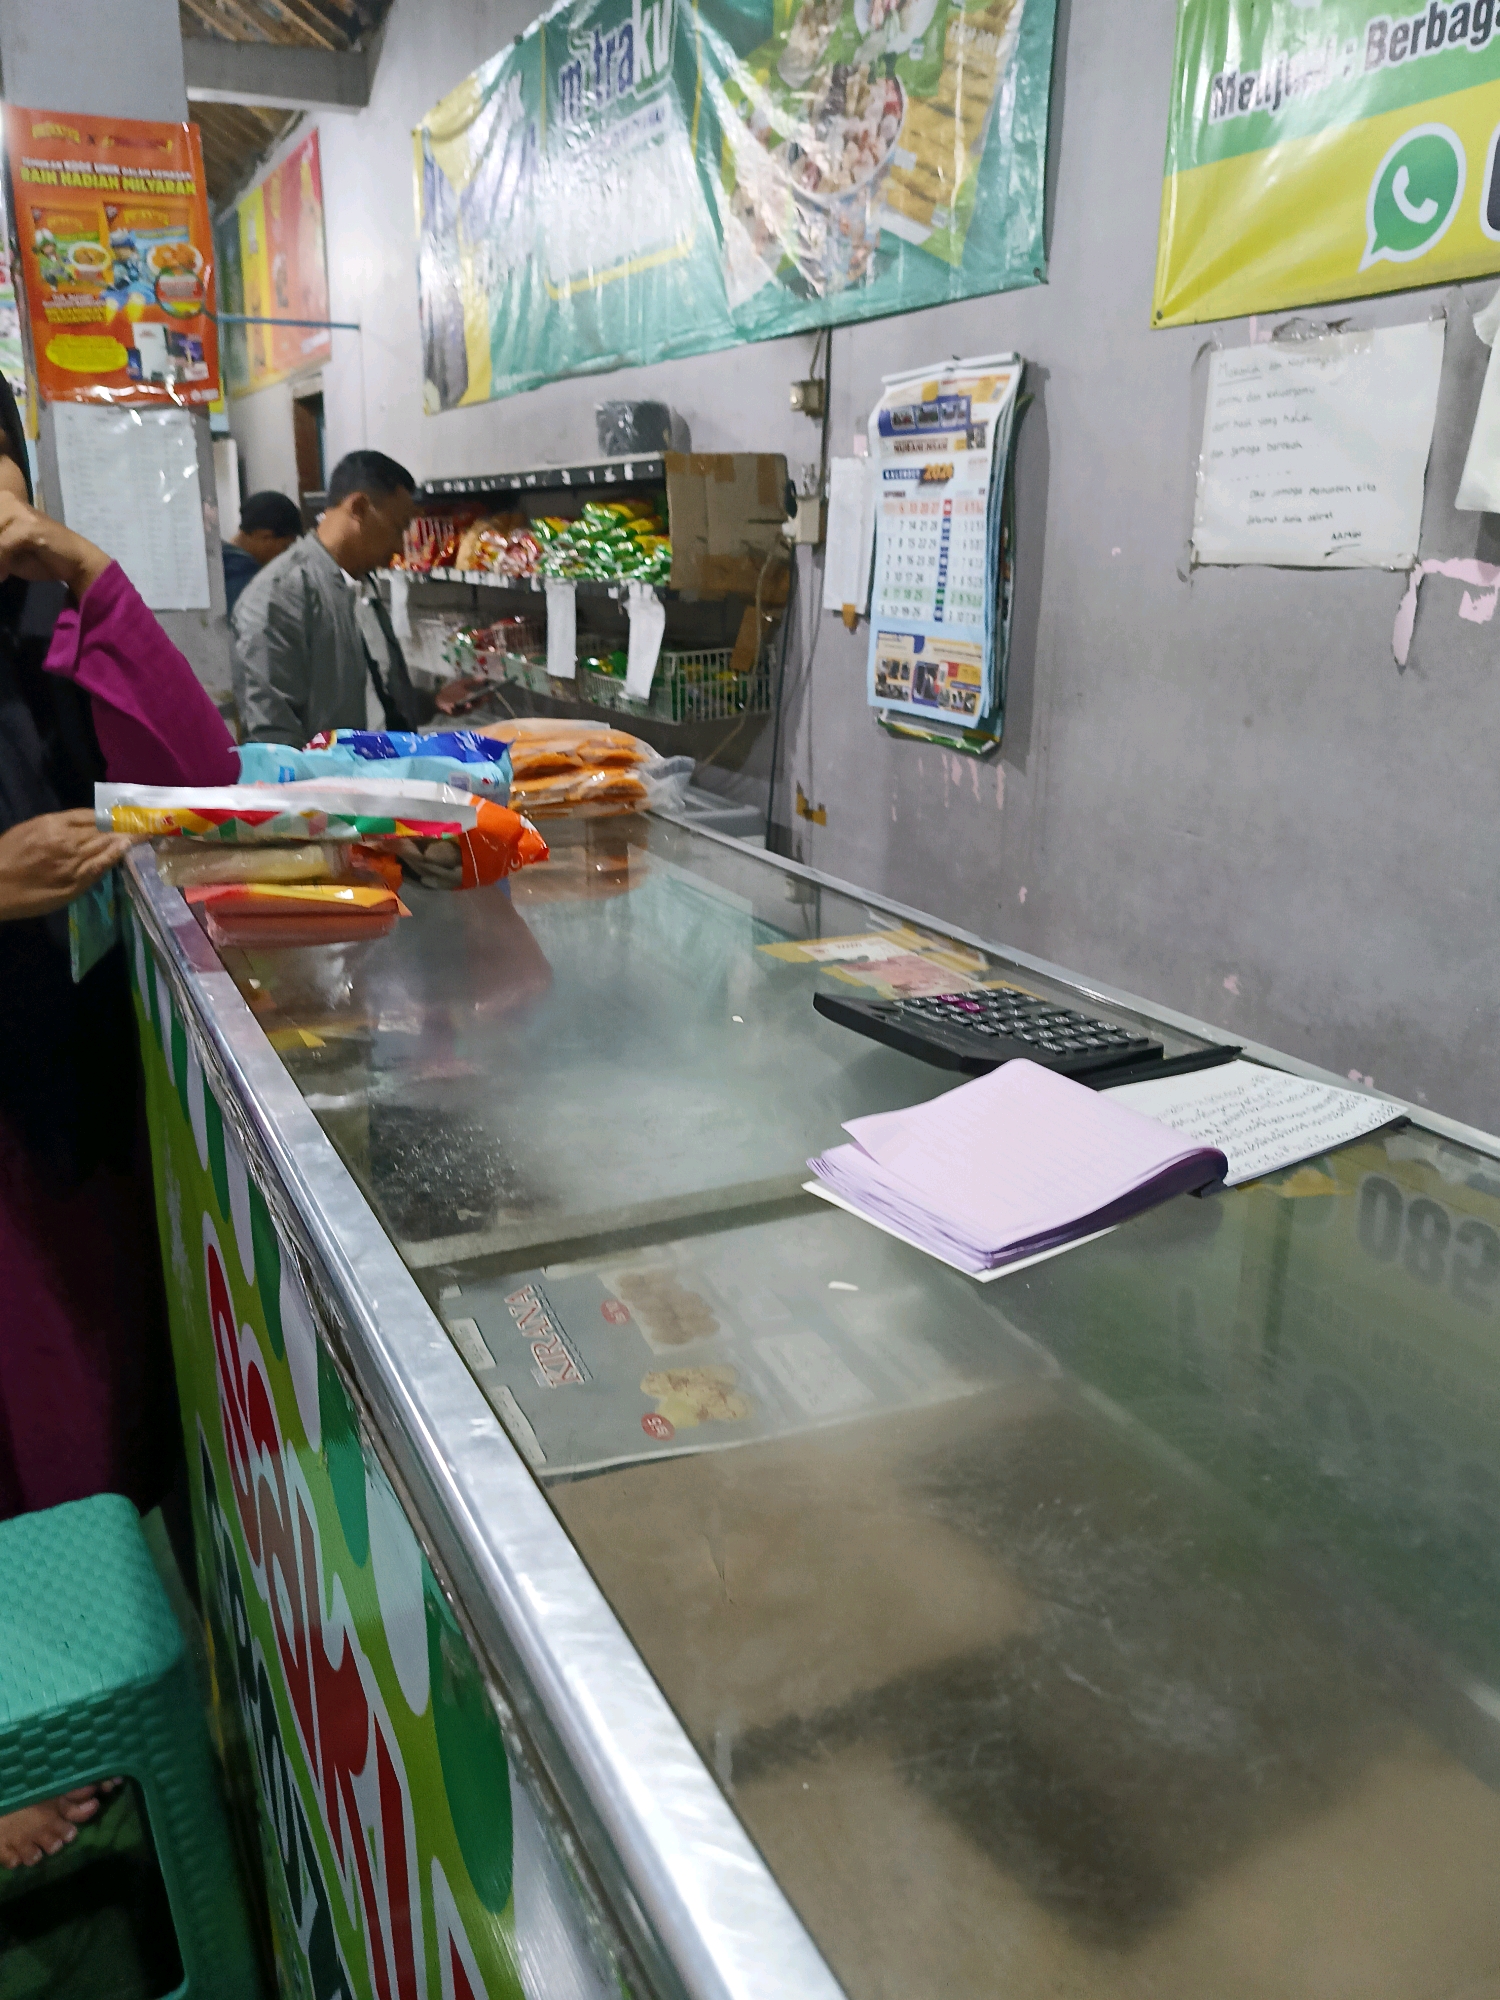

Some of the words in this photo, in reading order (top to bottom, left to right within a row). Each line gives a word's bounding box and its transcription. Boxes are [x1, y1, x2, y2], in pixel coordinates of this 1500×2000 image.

[61, 171, 119, 190] HADIAH
[122, 176, 196, 195] MILYARAN
[923, 463, 954, 481] 2020
[503, 1283, 584, 1388] KIRANA
